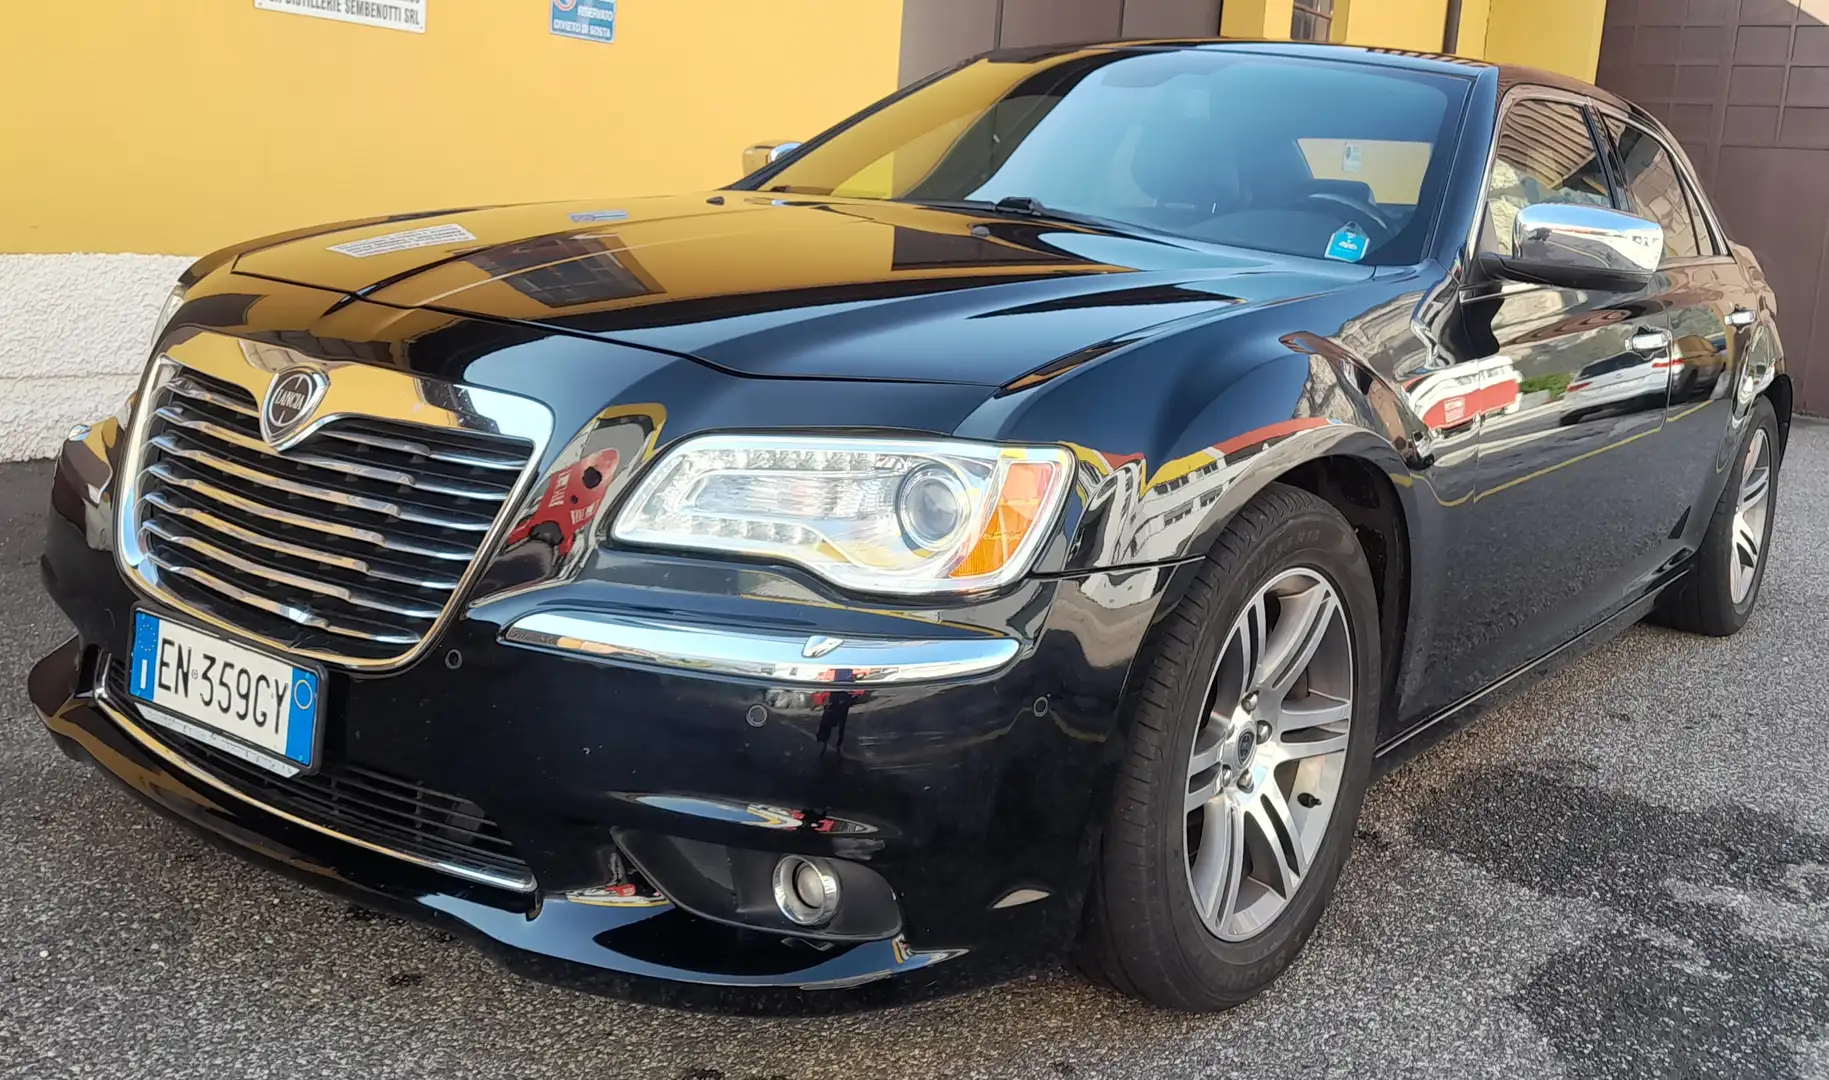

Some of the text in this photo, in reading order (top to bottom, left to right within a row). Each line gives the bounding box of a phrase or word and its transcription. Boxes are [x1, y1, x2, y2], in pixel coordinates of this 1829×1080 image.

[345, 2, 402, 23] SEMBENOTTI
[404, 8, 420, 25] SRL
[553, 18, 581, 33] DIVIETO
[590, 25, 611, 38] SOSTA
[275, 388, 306, 411] LANCIA
[157, 637, 192, 699] EN
[199, 653, 289, 735] 359GY
